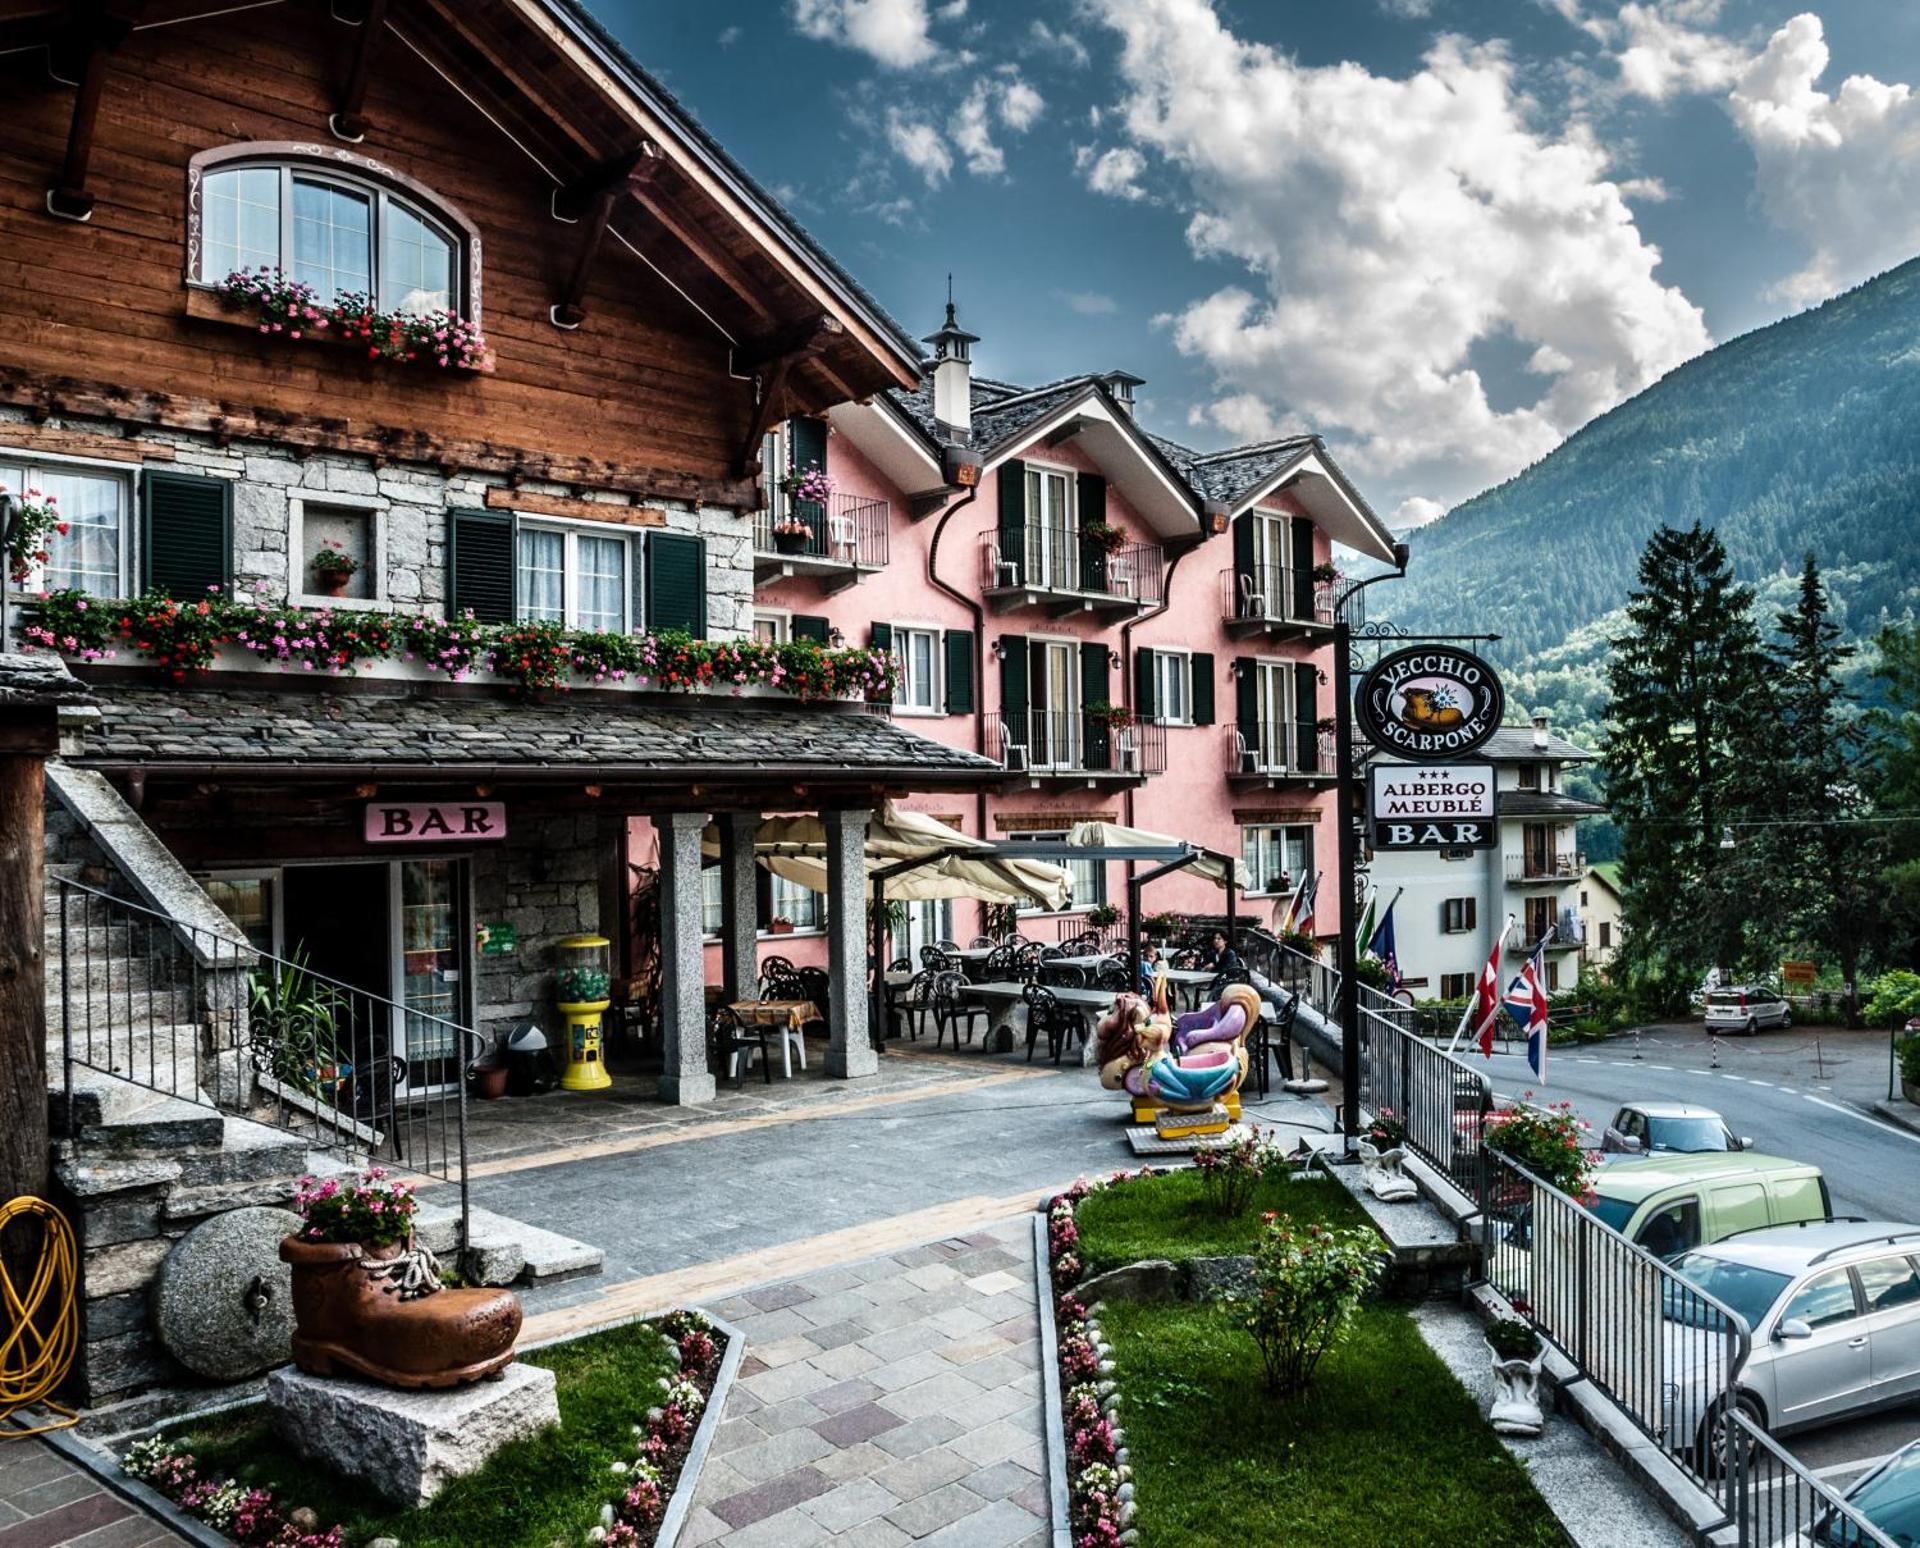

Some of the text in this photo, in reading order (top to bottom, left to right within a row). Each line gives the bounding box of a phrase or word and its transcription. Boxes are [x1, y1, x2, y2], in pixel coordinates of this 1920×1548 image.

[1379, 655, 1480, 685] VECCHIO
[1383, 718, 1486, 750] SCARPONE
[1383, 782, 1486, 797] ALBERGO
[1388, 797, 1482, 814] MEUBLÉ
[379, 807, 494, 836] BAR
[1387, 823, 1482, 845] BAR
